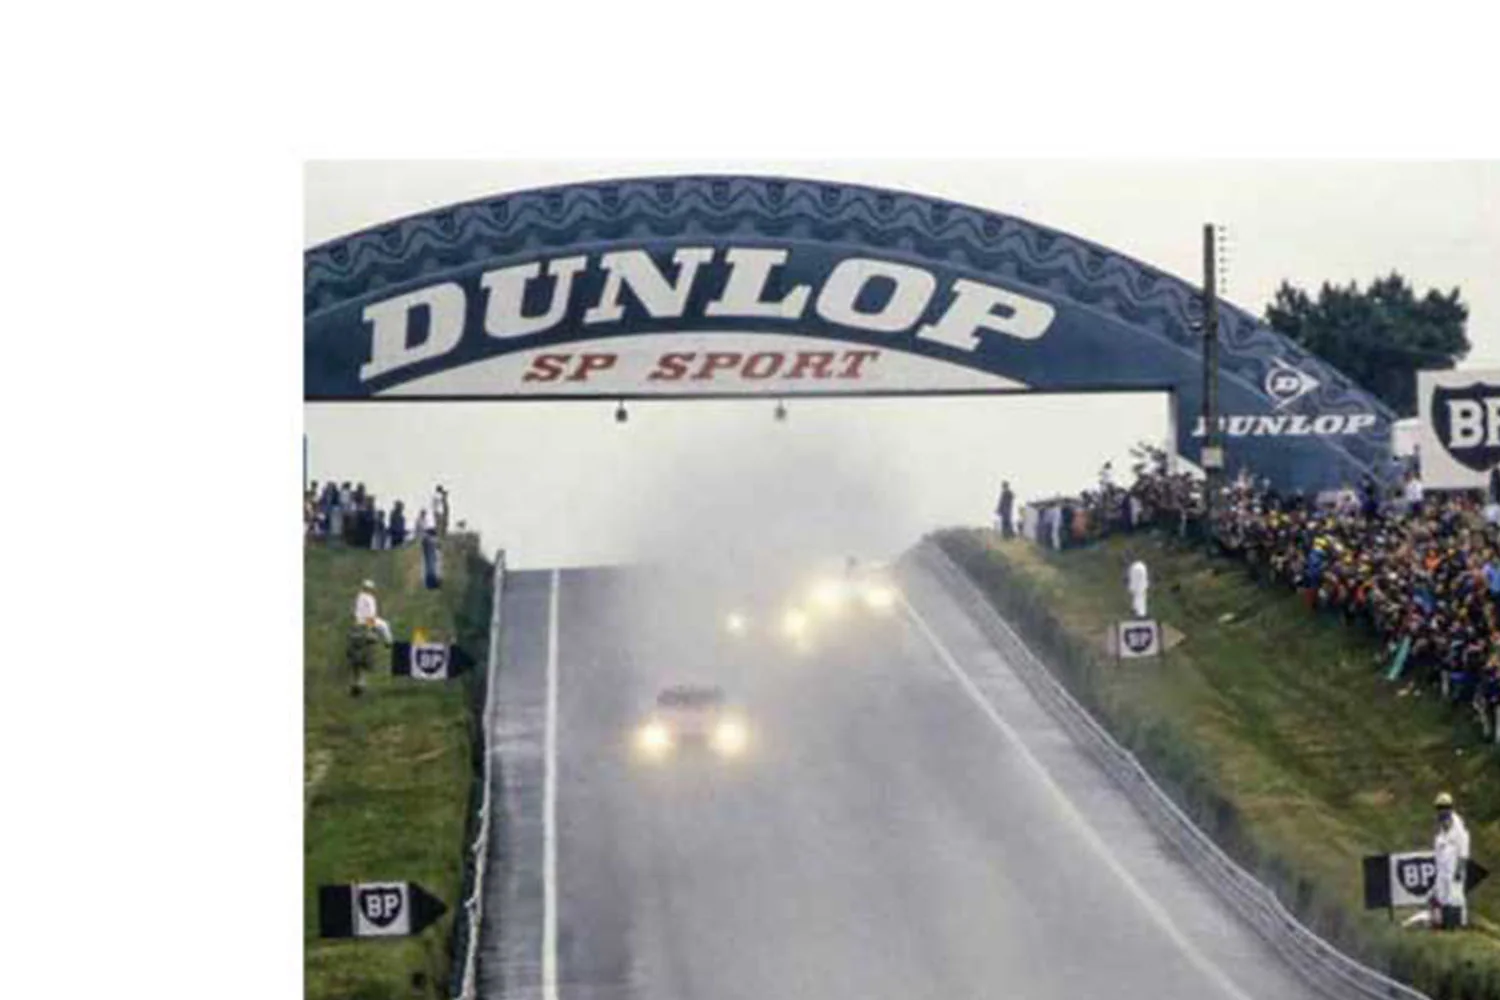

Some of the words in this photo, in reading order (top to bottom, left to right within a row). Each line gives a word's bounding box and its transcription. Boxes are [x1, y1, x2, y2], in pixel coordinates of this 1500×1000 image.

[358, 246, 1057, 382] DUNLOP
[522, 353, 617, 382] SP
[647, 350, 880, 380] SPORT
[1402, 862, 1436, 888] BP
[366, 893, 400, 919] BP
